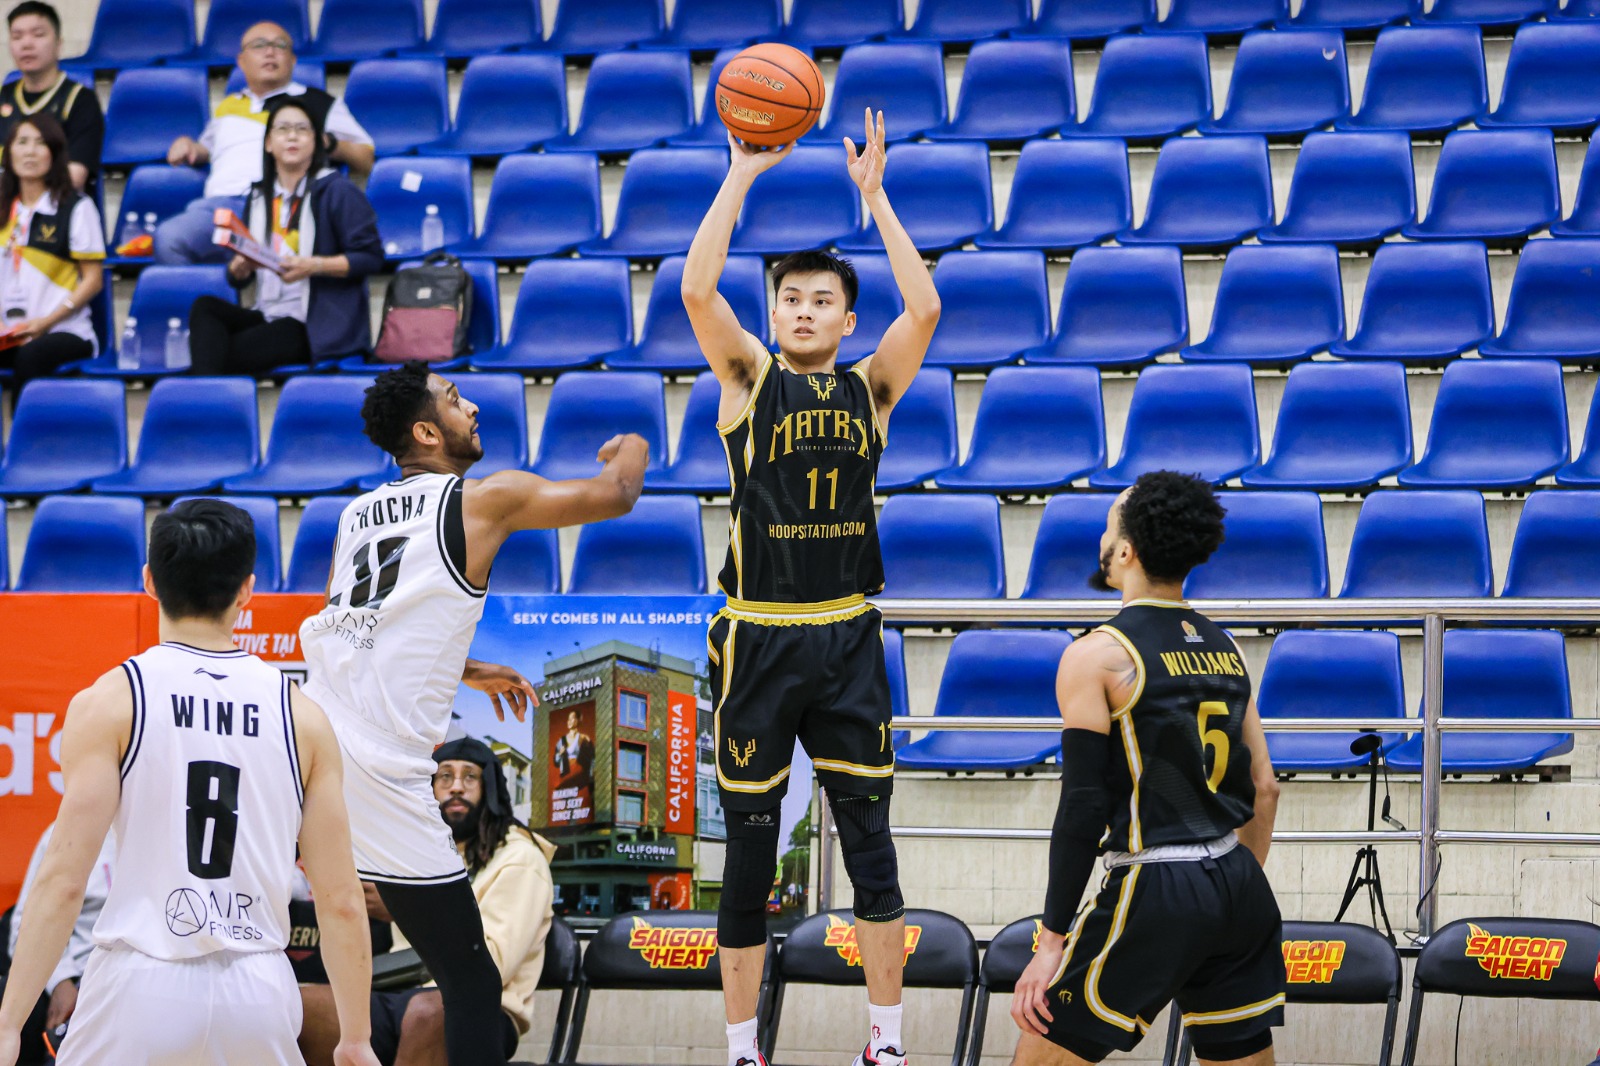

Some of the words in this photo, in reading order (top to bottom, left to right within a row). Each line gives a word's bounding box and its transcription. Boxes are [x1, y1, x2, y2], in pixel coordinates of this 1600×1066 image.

[768, 409, 870, 463] MATRX
[806, 467, 839, 510] 11
[768, 521, 866, 540] HOOPSTATIONCOM
[513, 612, 548, 625] SEXY
[551, 612, 599, 625] COMES
[602, 612, 617, 625] IN
[619, 612, 645, 625] ALL
[649, 612, 702, 625] SHAPES
[334, 624, 375, 650] FITNESS
[1160, 651, 1245, 677] WILLIAMS
[541, 676, 602, 702] CALIFORNIA
[171, 694, 259, 737] WING
[1197, 701, 1230, 794] 5
[668, 703, 683, 823] CALIFORNIA
[681, 727, 690, 800] ACTIVE
[186, 760, 241, 880] 8
[616, 843, 676, 856] CALIFORNIA
[210, 921, 263, 940] FITNESS
[291, 926, 320, 948] ERV
[629, 927, 718, 949] SAIGON
[824, 925, 922, 947] SAN
[650, 948, 716, 969] HEAT
[1465, 935, 1567, 959] SAIGON
[1489, 957, 1560, 980] HEAT
